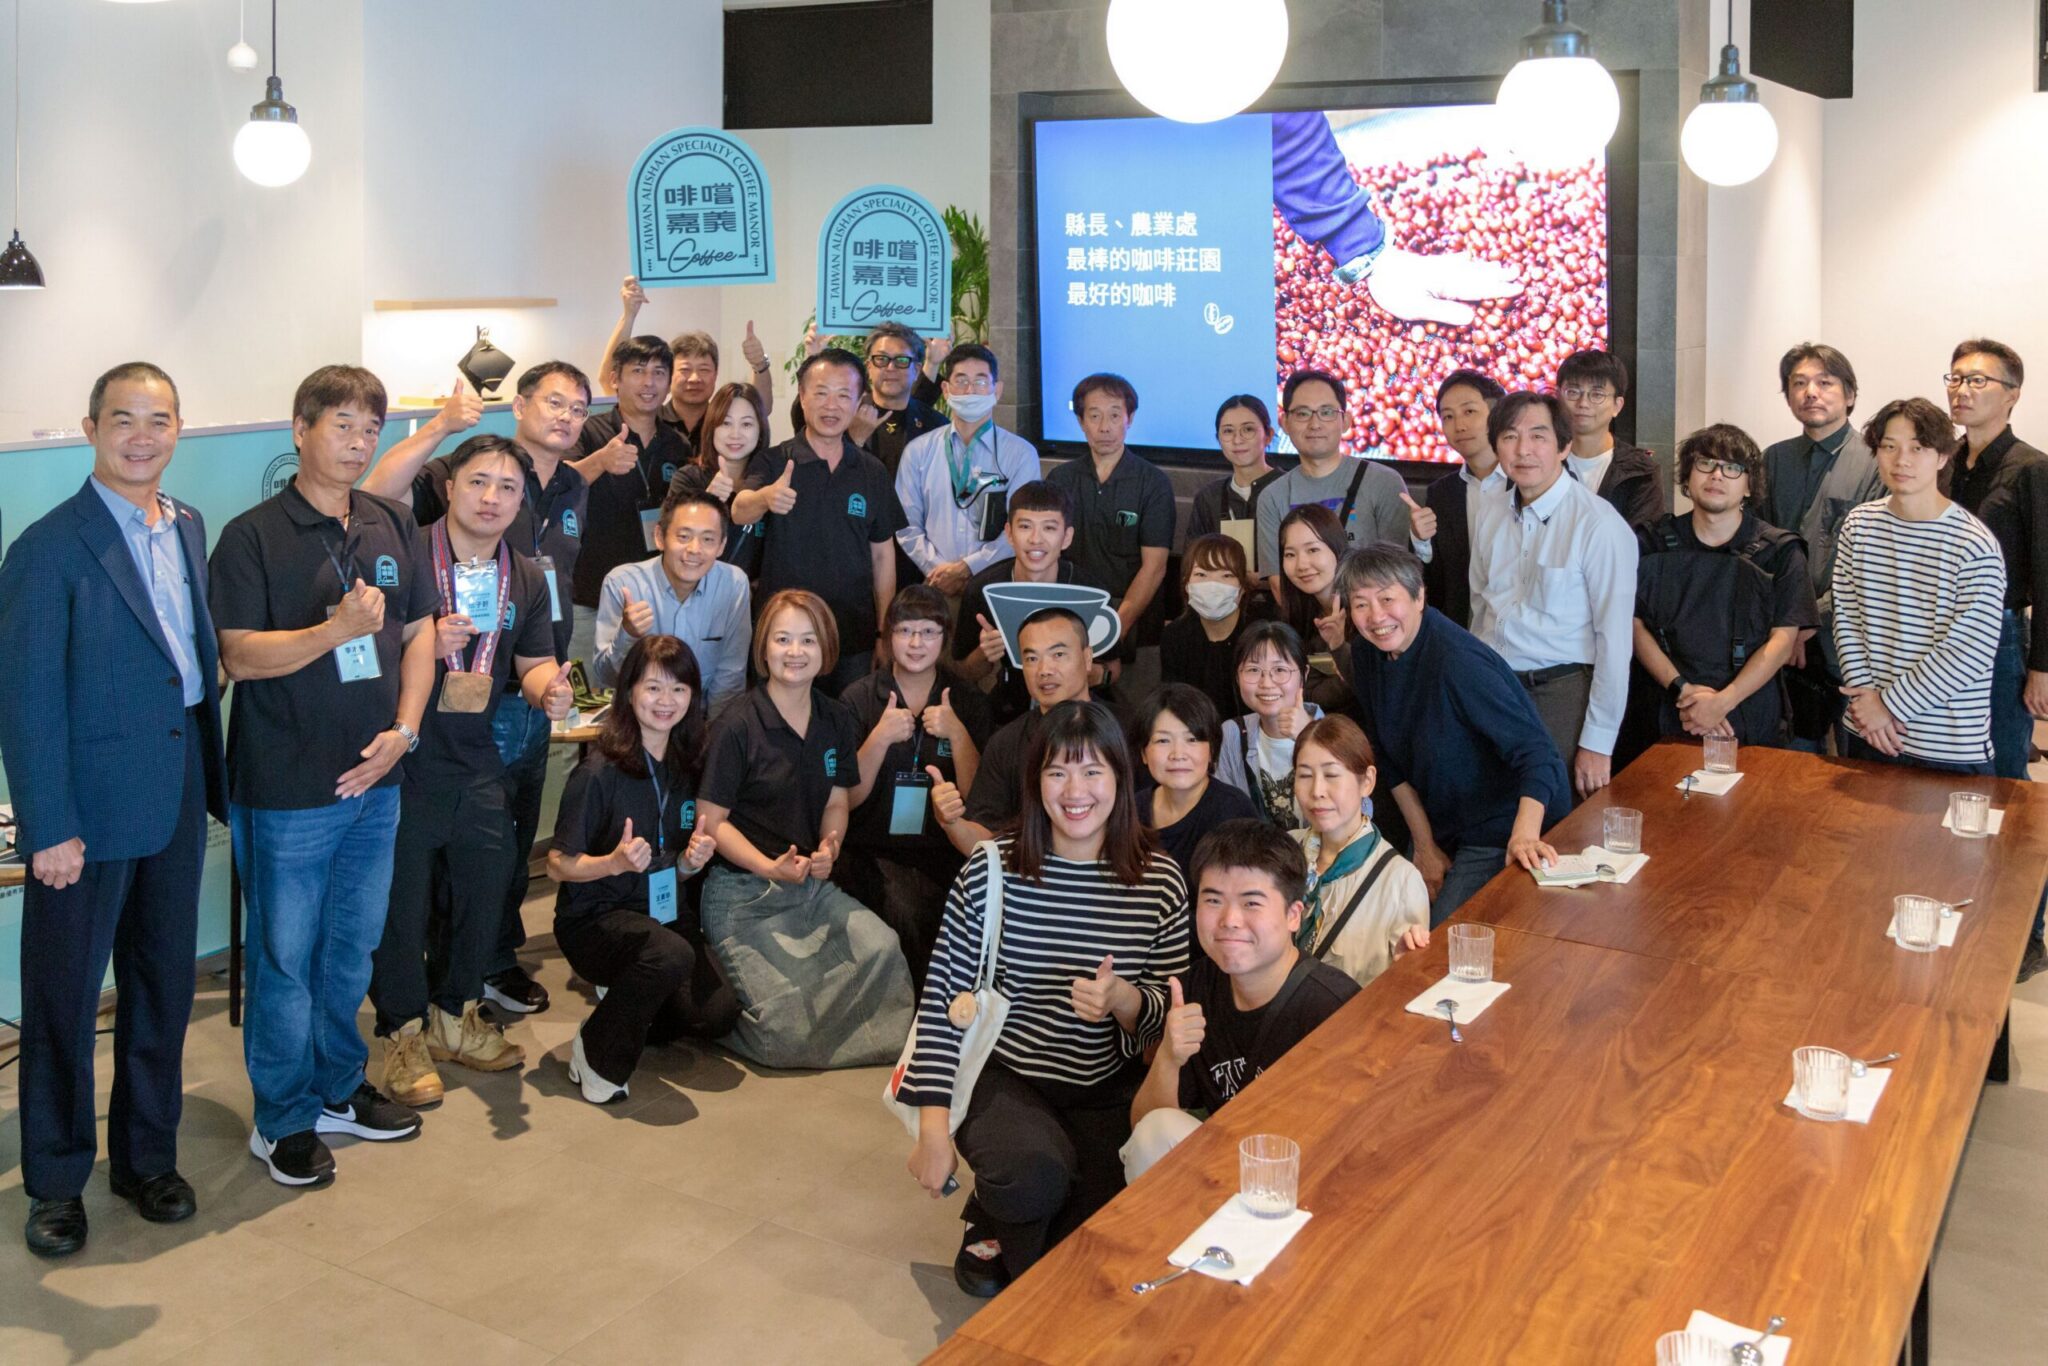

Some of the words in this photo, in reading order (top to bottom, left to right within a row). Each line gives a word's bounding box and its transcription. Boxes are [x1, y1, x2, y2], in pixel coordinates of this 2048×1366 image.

[670, 139, 733, 158] SPECIALTY
[641, 151, 671, 199] ALISHAN
[732, 156, 758, 198] COFFEE
[664, 182, 734, 206] 啡嚐
[862, 197, 920, 217] SPECIALTY
[642, 204, 655, 252] TAIWAN
[665, 210, 737, 235] 嘉義
[748, 201, 760, 248] MANOR
[831, 207, 862, 252] ALISHAN
[918, 215, 940, 257] COFFEE
[1065, 211, 1198, 237] 縣長、農業處
[667, 237, 737, 273] Coffee
[1066, 246, 1222, 273] 最棒的咖啡莊園
[830, 254, 840, 299] TAIWAN
[852, 265, 918, 287] 嘉義
[929, 260, 940, 304] MANOR
[851, 289, 917, 322] Coffee
[1067, 281, 1177, 308] 最好的咖啡
